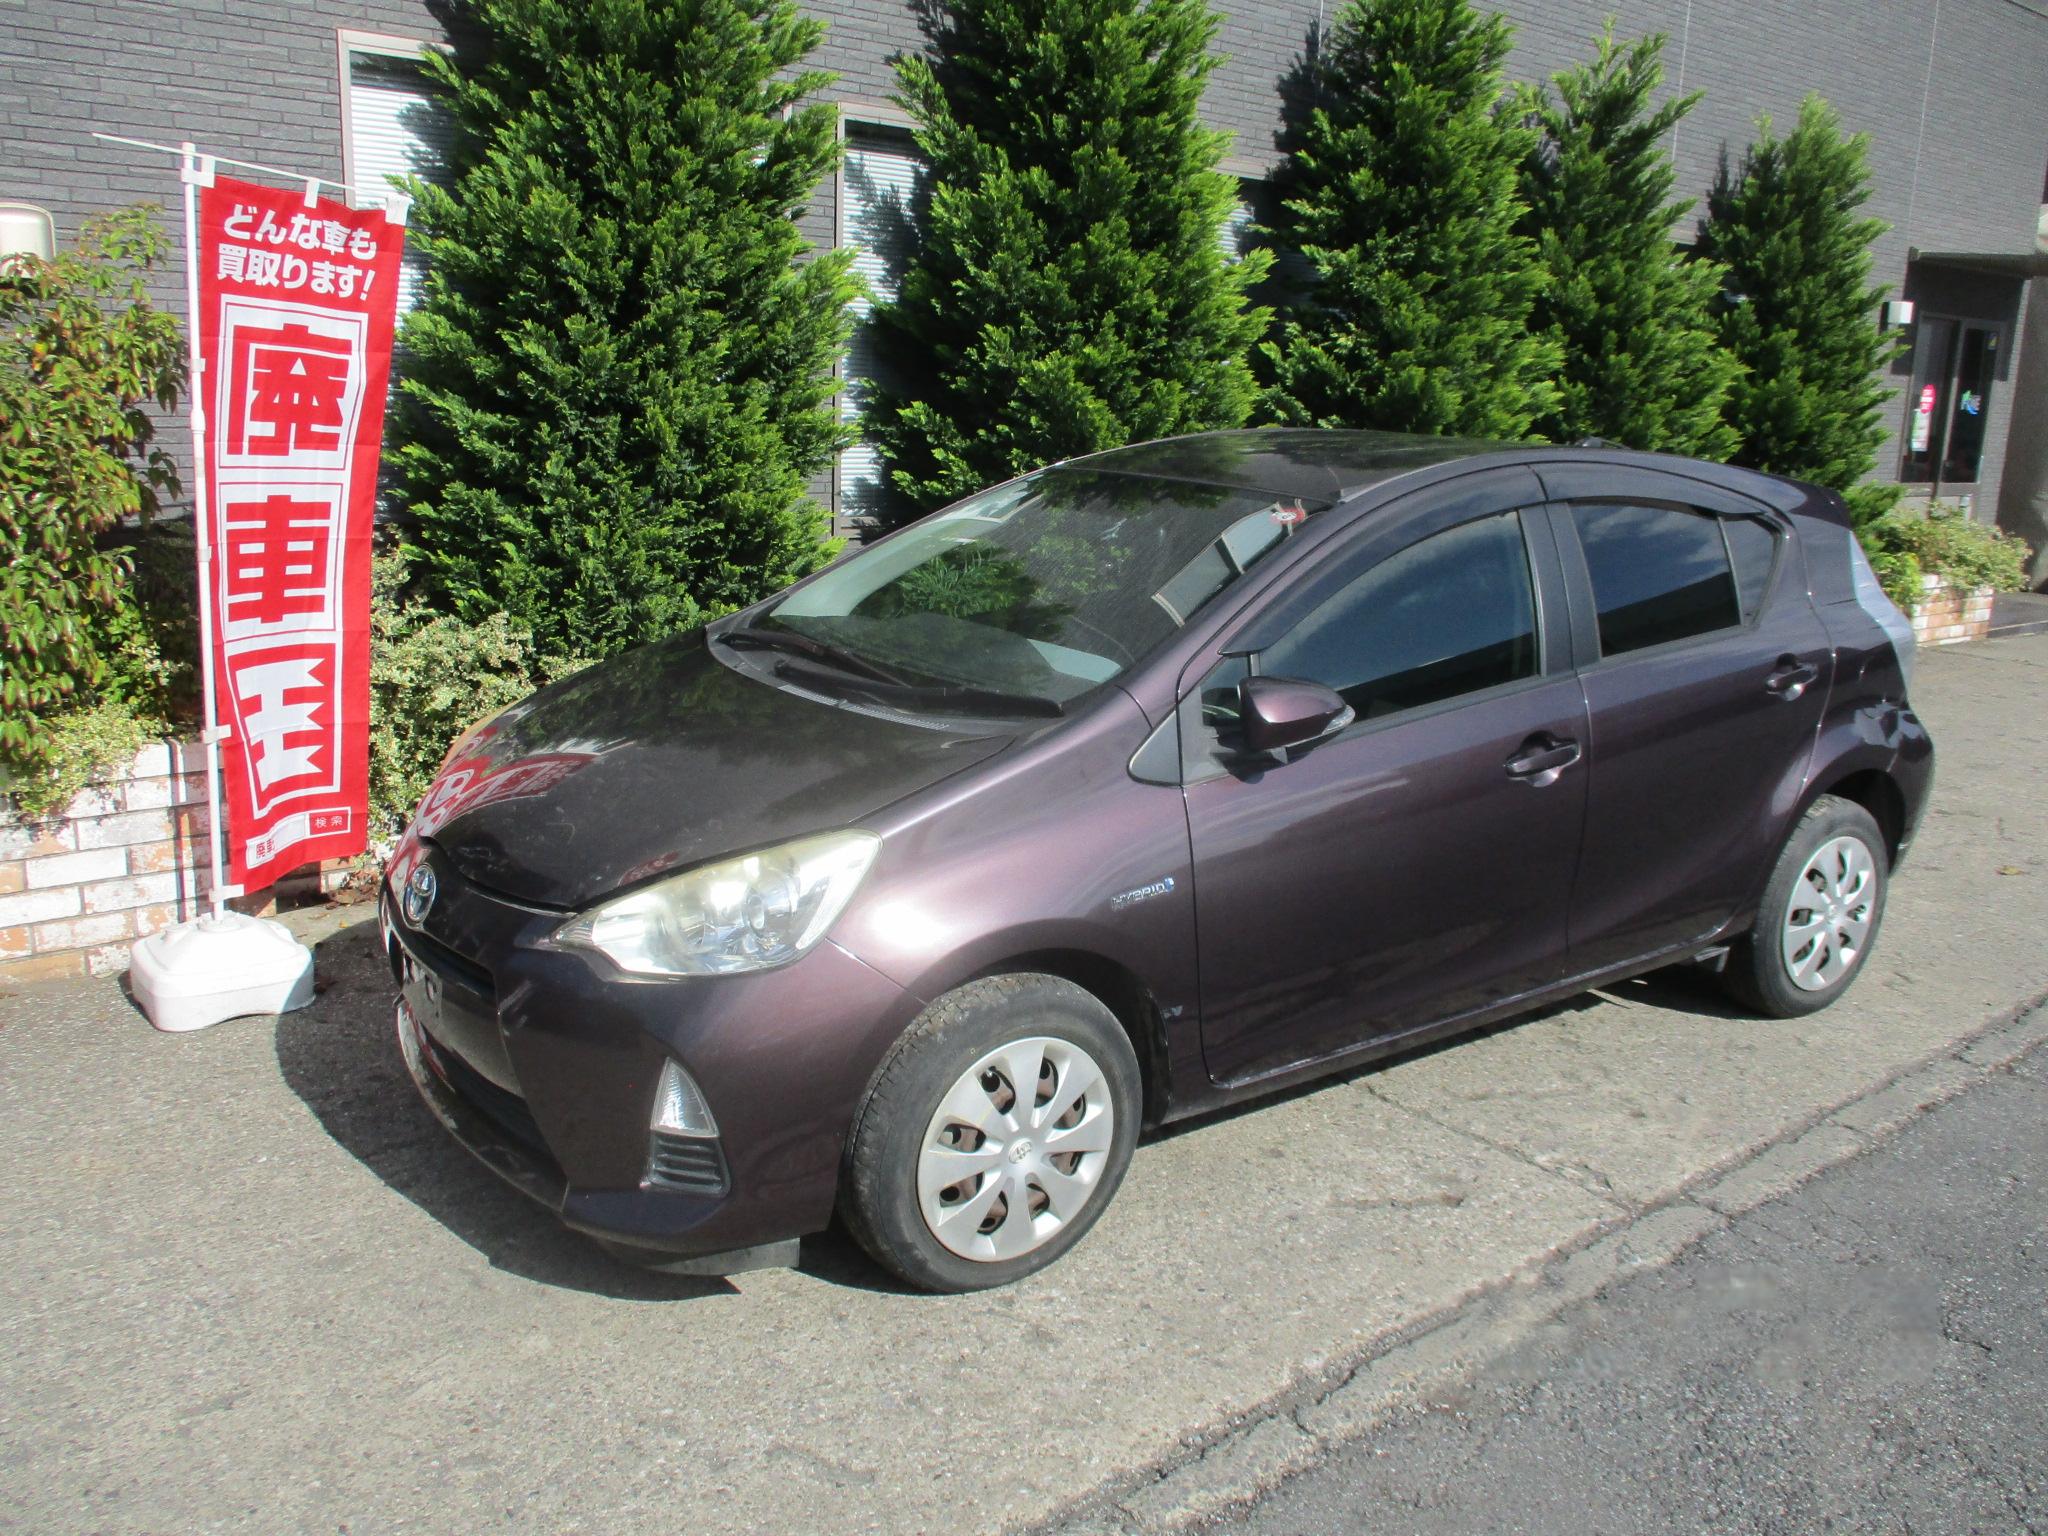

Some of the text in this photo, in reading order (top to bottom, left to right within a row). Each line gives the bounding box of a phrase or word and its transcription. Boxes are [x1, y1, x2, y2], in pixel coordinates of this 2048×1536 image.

[223, 204, 377, 260] どんな車も
[217, 243, 375, 301] 買取ります!
[226, 323, 353, 792] 廃車王
[314, 815, 343, 829] 検索
[1111, 883, 1166, 908] HYBRID
